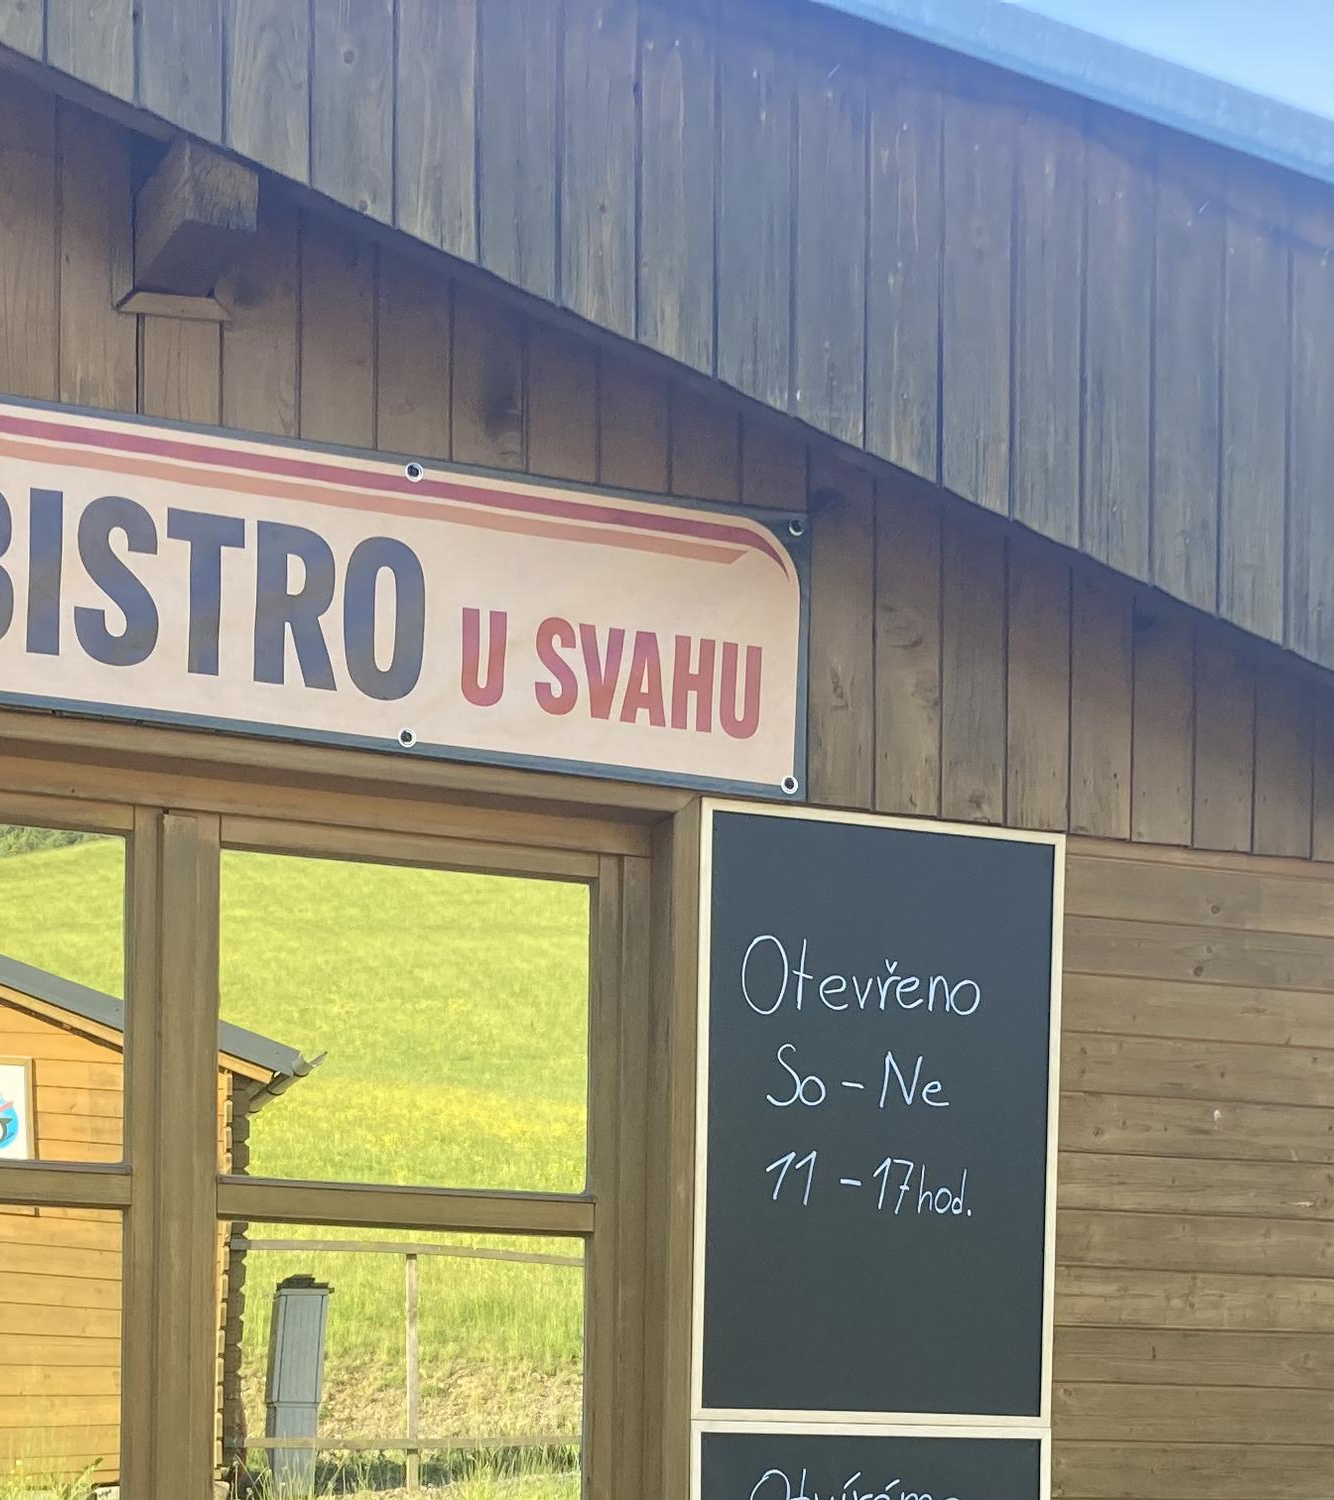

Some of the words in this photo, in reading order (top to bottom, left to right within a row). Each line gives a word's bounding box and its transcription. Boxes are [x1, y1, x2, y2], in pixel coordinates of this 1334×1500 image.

[461, 607, 507, 706] U
[535, 617, 762, 739] SVAHU
[742, 935, 980, 1015] Otevřeno
[880, 1051, 949, 1107] Ne
